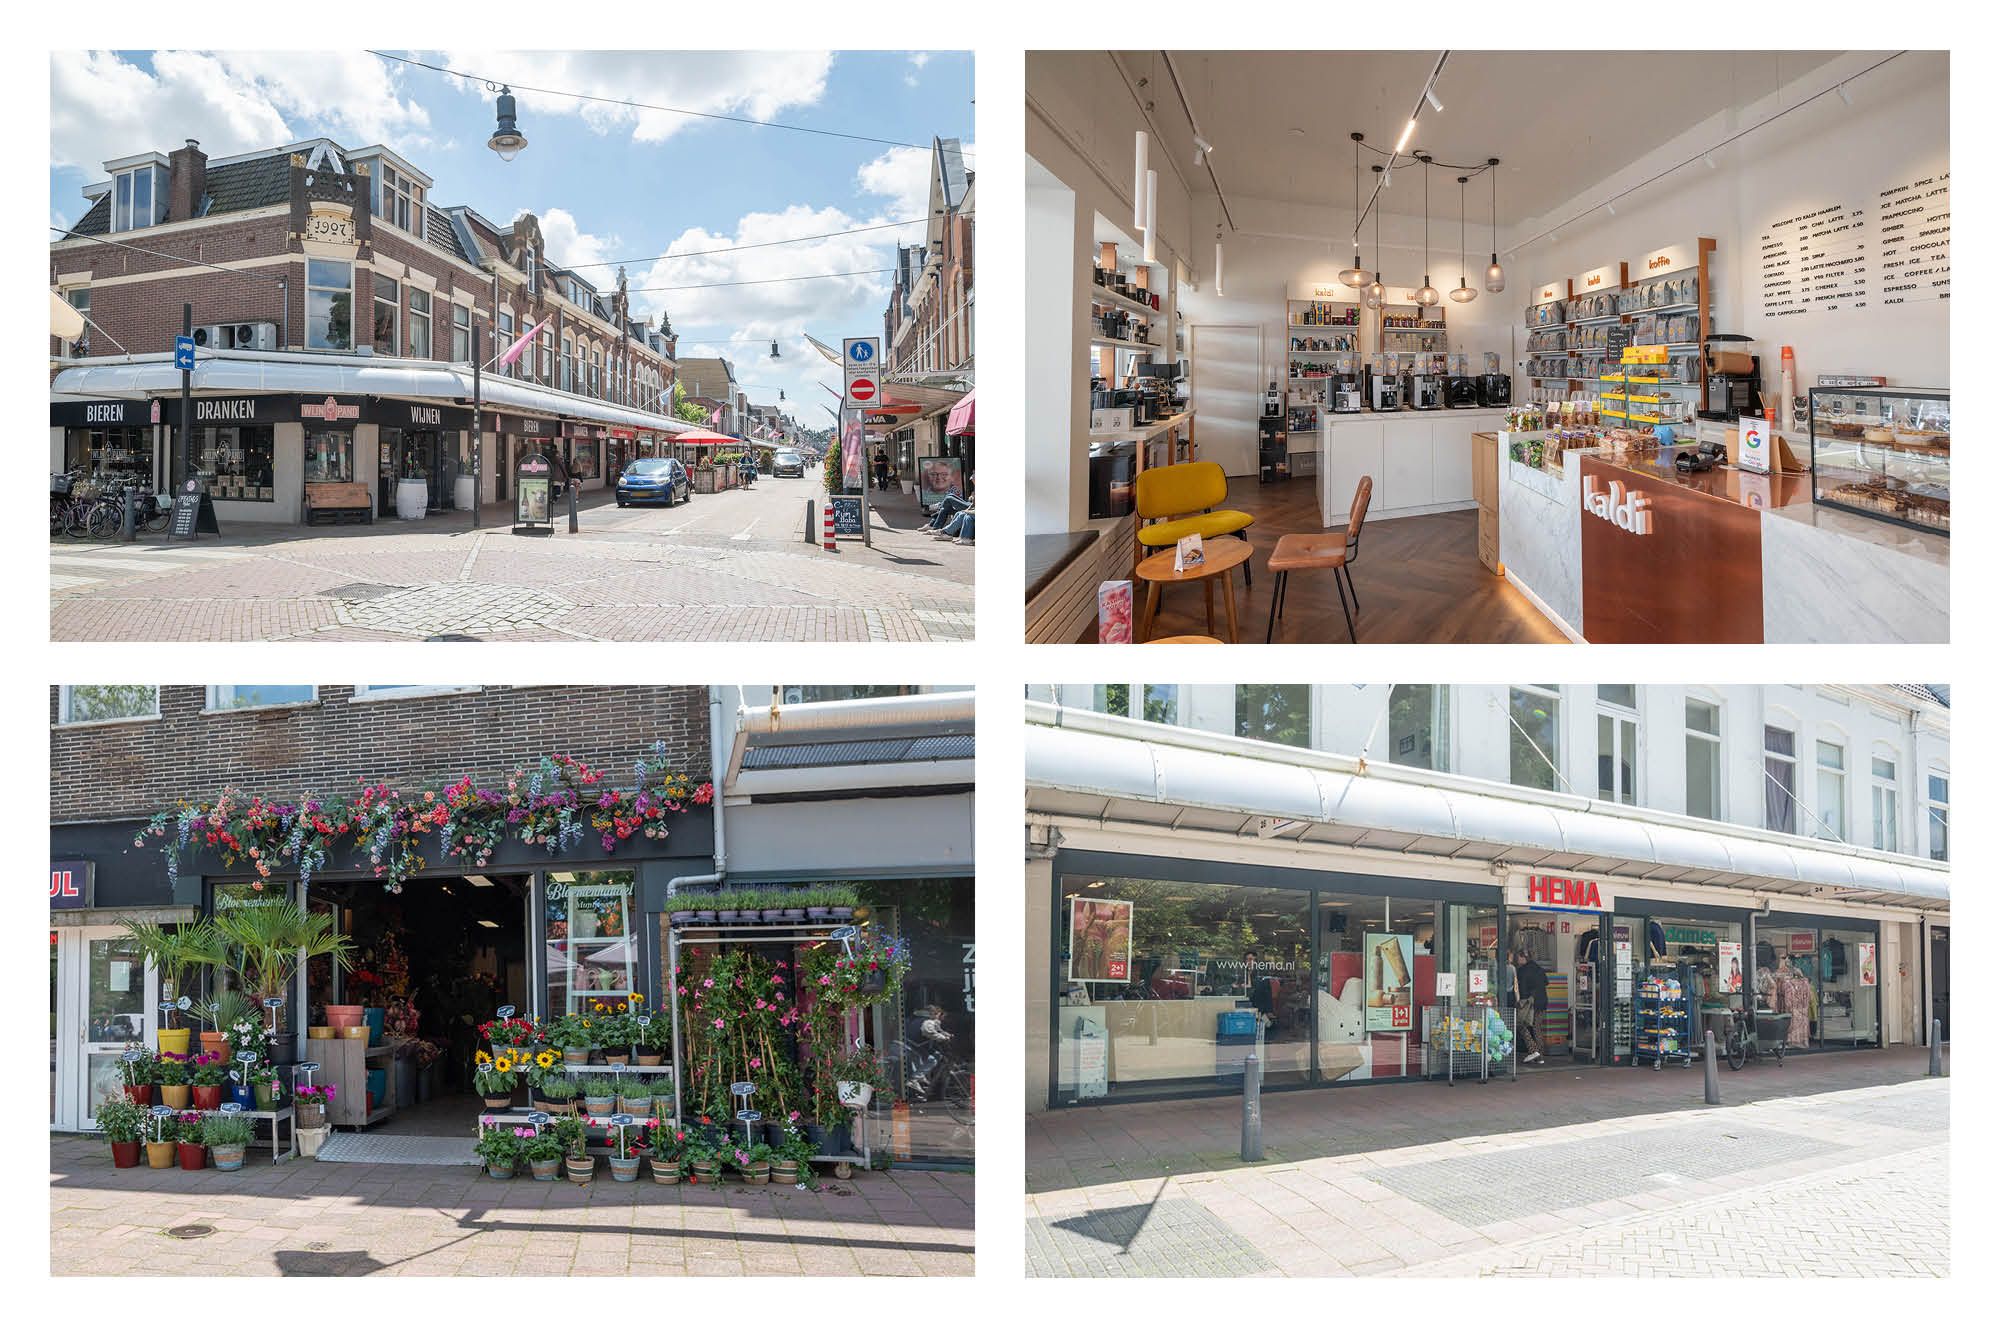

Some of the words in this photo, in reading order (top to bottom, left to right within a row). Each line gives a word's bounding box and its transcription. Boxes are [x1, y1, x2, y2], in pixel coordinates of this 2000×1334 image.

[1881, 185, 1908, 197] PUMPKIN
[1914, 178, 1933, 188] SPICE
[1940, 172, 1950, 180] LA
[1926, 187, 1947, 198] LATTE
[1828, 215, 1844, 223] LATTE
[1648, 256, 1671, 270] koffie
[1904, 269, 1933, 277] COFFEE
[1884, 284, 1917, 292] ESPRESSO
[87, 404, 124, 422] BIEREN
[197, 400, 255, 420] DRANKEN
[337, 407, 358, 418] PAND
[411, 406, 441, 425] WIJNEN
[1583, 475, 1648, 535] kaldi
[1530, 875, 1602, 908] HEMA
[1666, 927, 1716, 945] dames
[1216, 960, 1295, 971] www.hema.nl
[1394, 1007, 1408, 1018] 1+1
